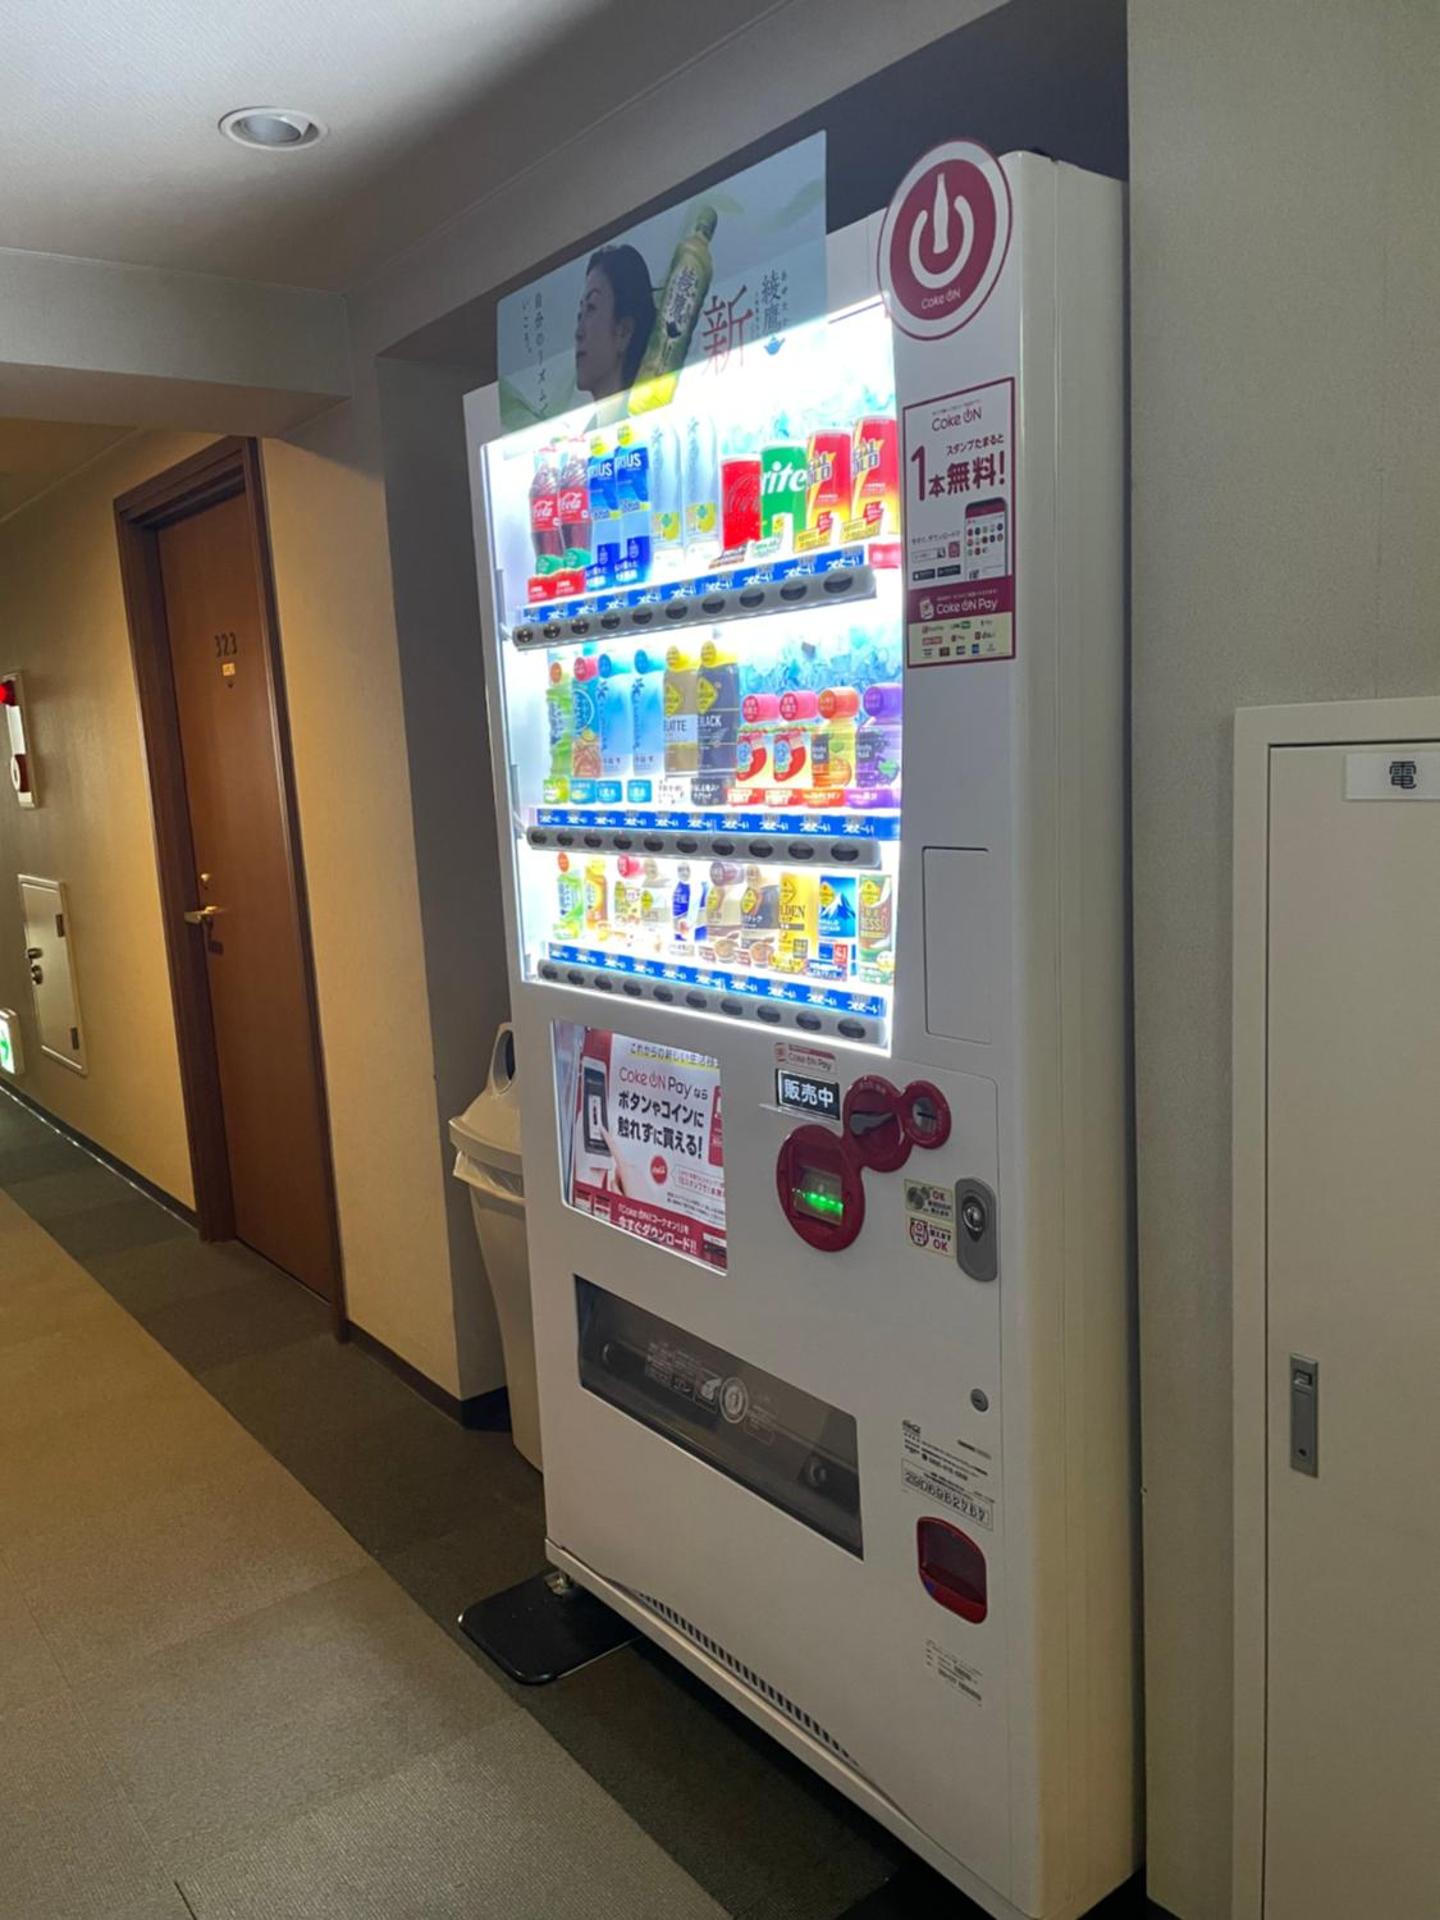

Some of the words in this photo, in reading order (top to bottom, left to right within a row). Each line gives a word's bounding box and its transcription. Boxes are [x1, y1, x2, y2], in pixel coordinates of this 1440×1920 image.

[921, 294, 945, 310] Coke
[945, 287, 962, 302] ON
[702, 285, 753, 377] 新
[931, 413, 961, 432] Coke
[962, 406, 983, 424] ON
[946, 433, 1005, 456] スタンプたまると
[910, 445, 1005, 501] 1本無料!
[936, 602, 961, 615] Coke
[978, 597, 998, 613] Pay
[1389, 761, 1417, 789] 電
[619, 1066, 649, 1084] Coke
[649, 1070, 667, 1089] ON
[668, 1076, 696, 1100] Pay
[693, 1088, 709, 1101] なら
[783, 1078, 834, 1109] 販売中
[617, 1090, 705, 1129] ボタンやコインに
[617, 1115, 704, 1160] 触れずに買える!
[932, 1238, 949, 1253] OK
